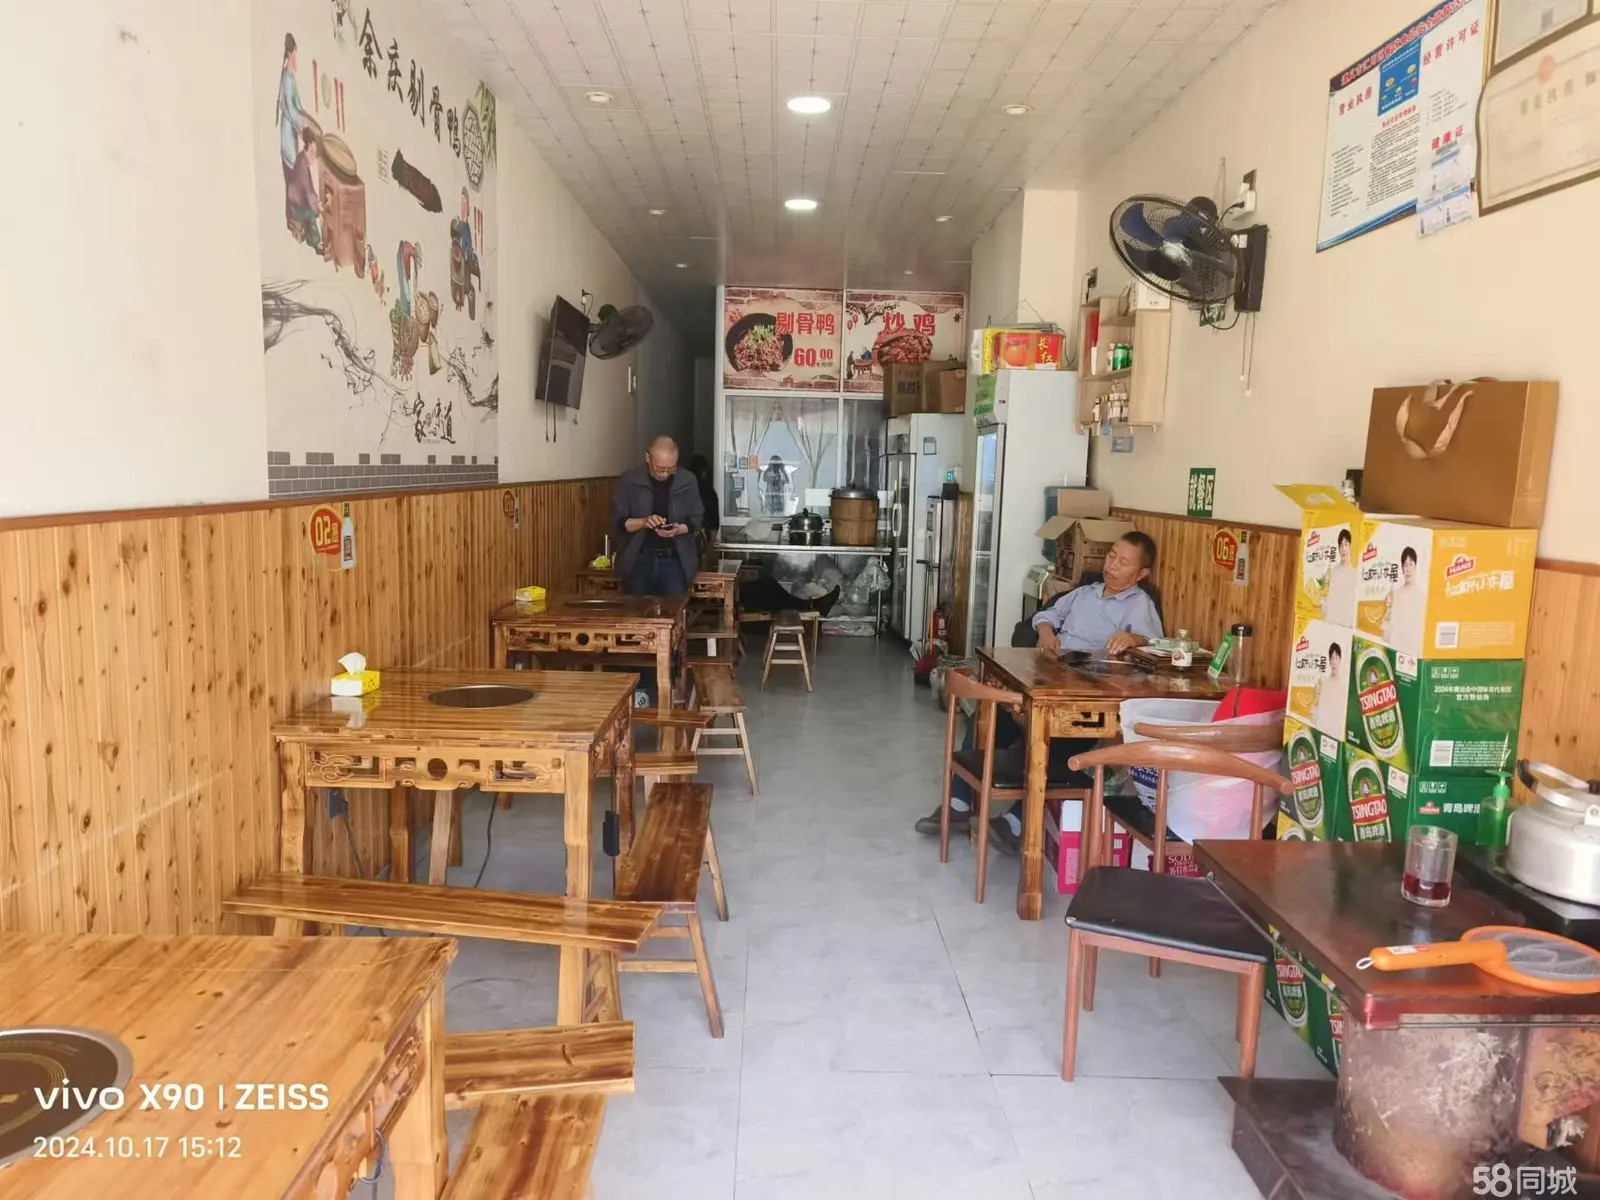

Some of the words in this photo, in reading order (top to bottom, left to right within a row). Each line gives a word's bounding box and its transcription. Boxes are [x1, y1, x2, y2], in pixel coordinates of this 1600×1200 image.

[776, 311, 835, 336] 剔骨鸭
[883, 312, 936, 337] 炒鸡
[1189, 473, 1214, 511] 就餐区
[1360, 684, 1397, 711] TSINGTAO
[1352, 799, 1388, 820] TSINGTAO
